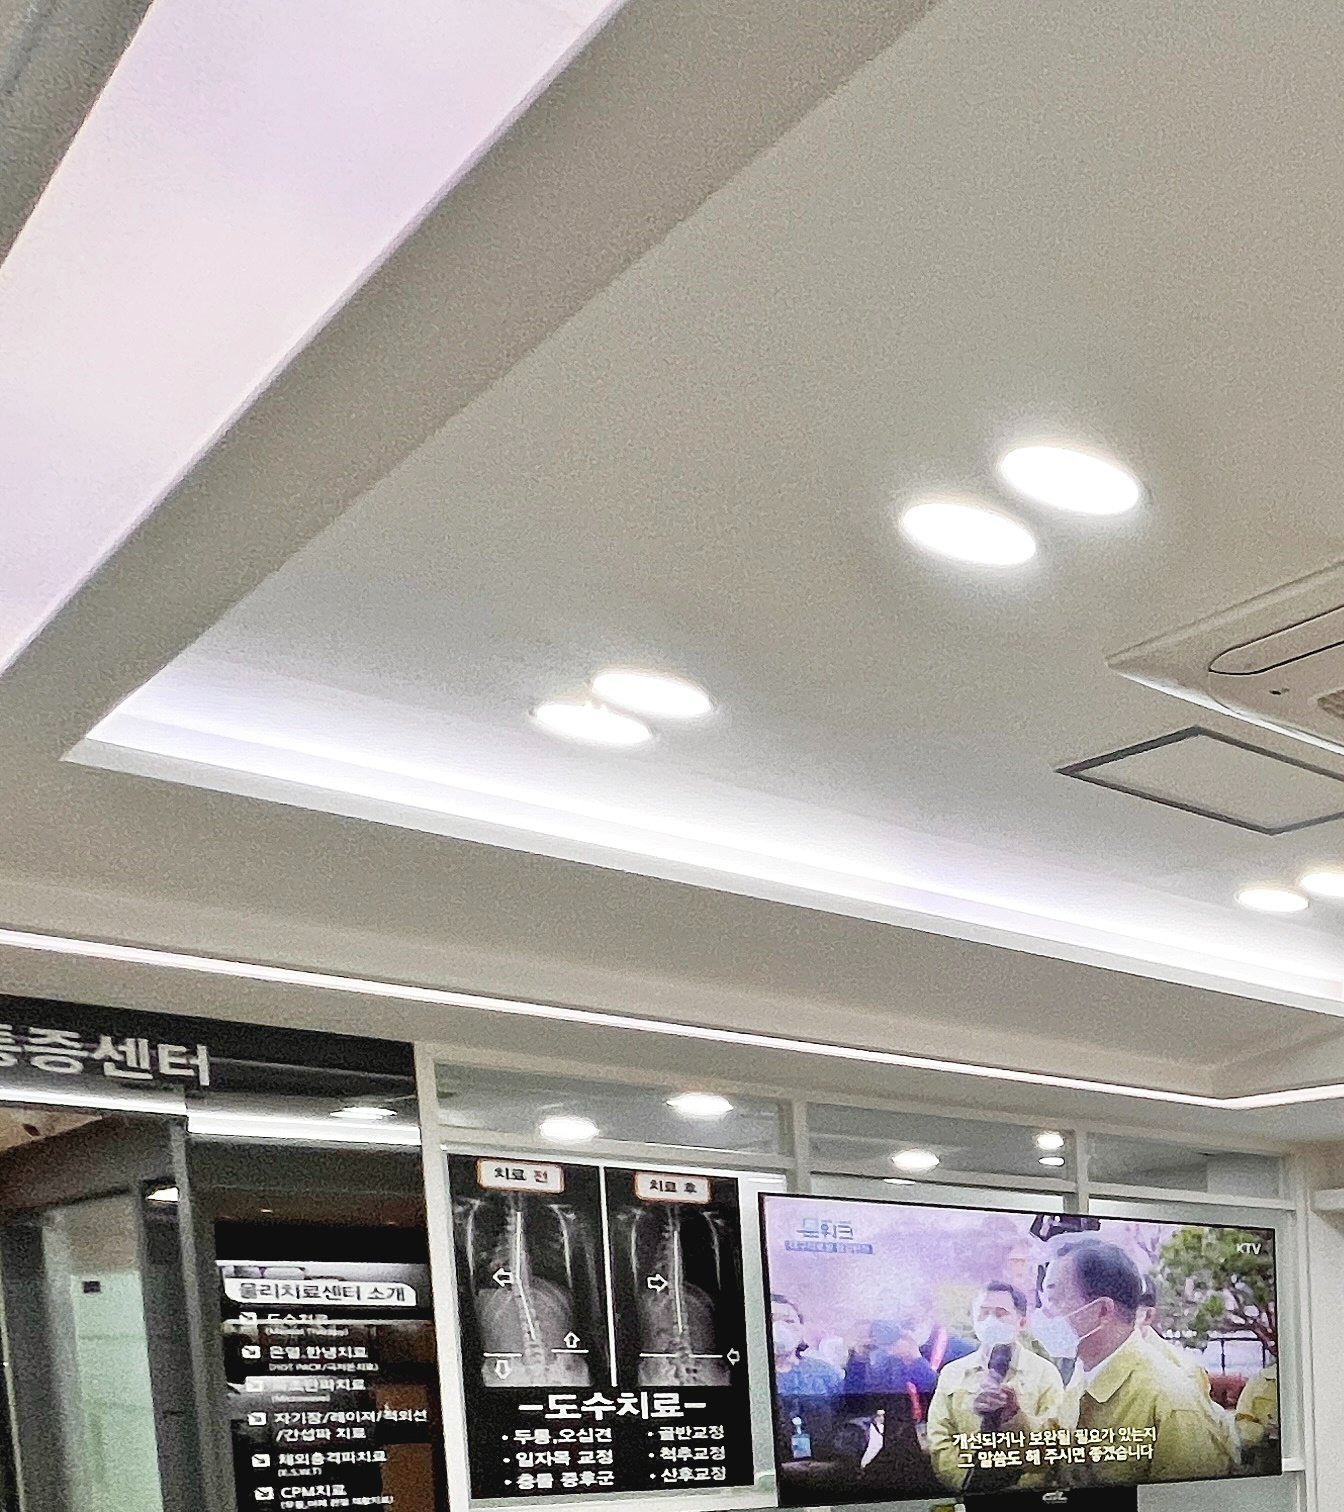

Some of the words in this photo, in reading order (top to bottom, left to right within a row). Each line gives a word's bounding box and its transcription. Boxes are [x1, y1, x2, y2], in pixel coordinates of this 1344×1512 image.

[495, 1167, 526, 1181] 치료
[534, 1168, 548, 1183] 전
[649, 1178, 678, 1191] 치료
[684, 1181, 697, 1194] 후
[240, 1283, 360, 1300] 물리치료센터
[368, 1286, 405, 1302] 소개
[337, 1427, 366, 1439] 치료
[952, 1431, 1025, 1450] 개선되거나
[1076, 1428, 1115, 1445] 필요가
[1118, 1426, 1157, 1443] 있는지
[577, 1450, 613, 1465] 교정
[957, 1453, 975, 1468] 그
[978, 1450, 1022, 1468] 말씀도
[1025, 1449, 1041, 1465] 해
[1044, 1447, 1085, 1464] 주시면
[1089, 1444, 1153, 1462] 좋겠습니다
